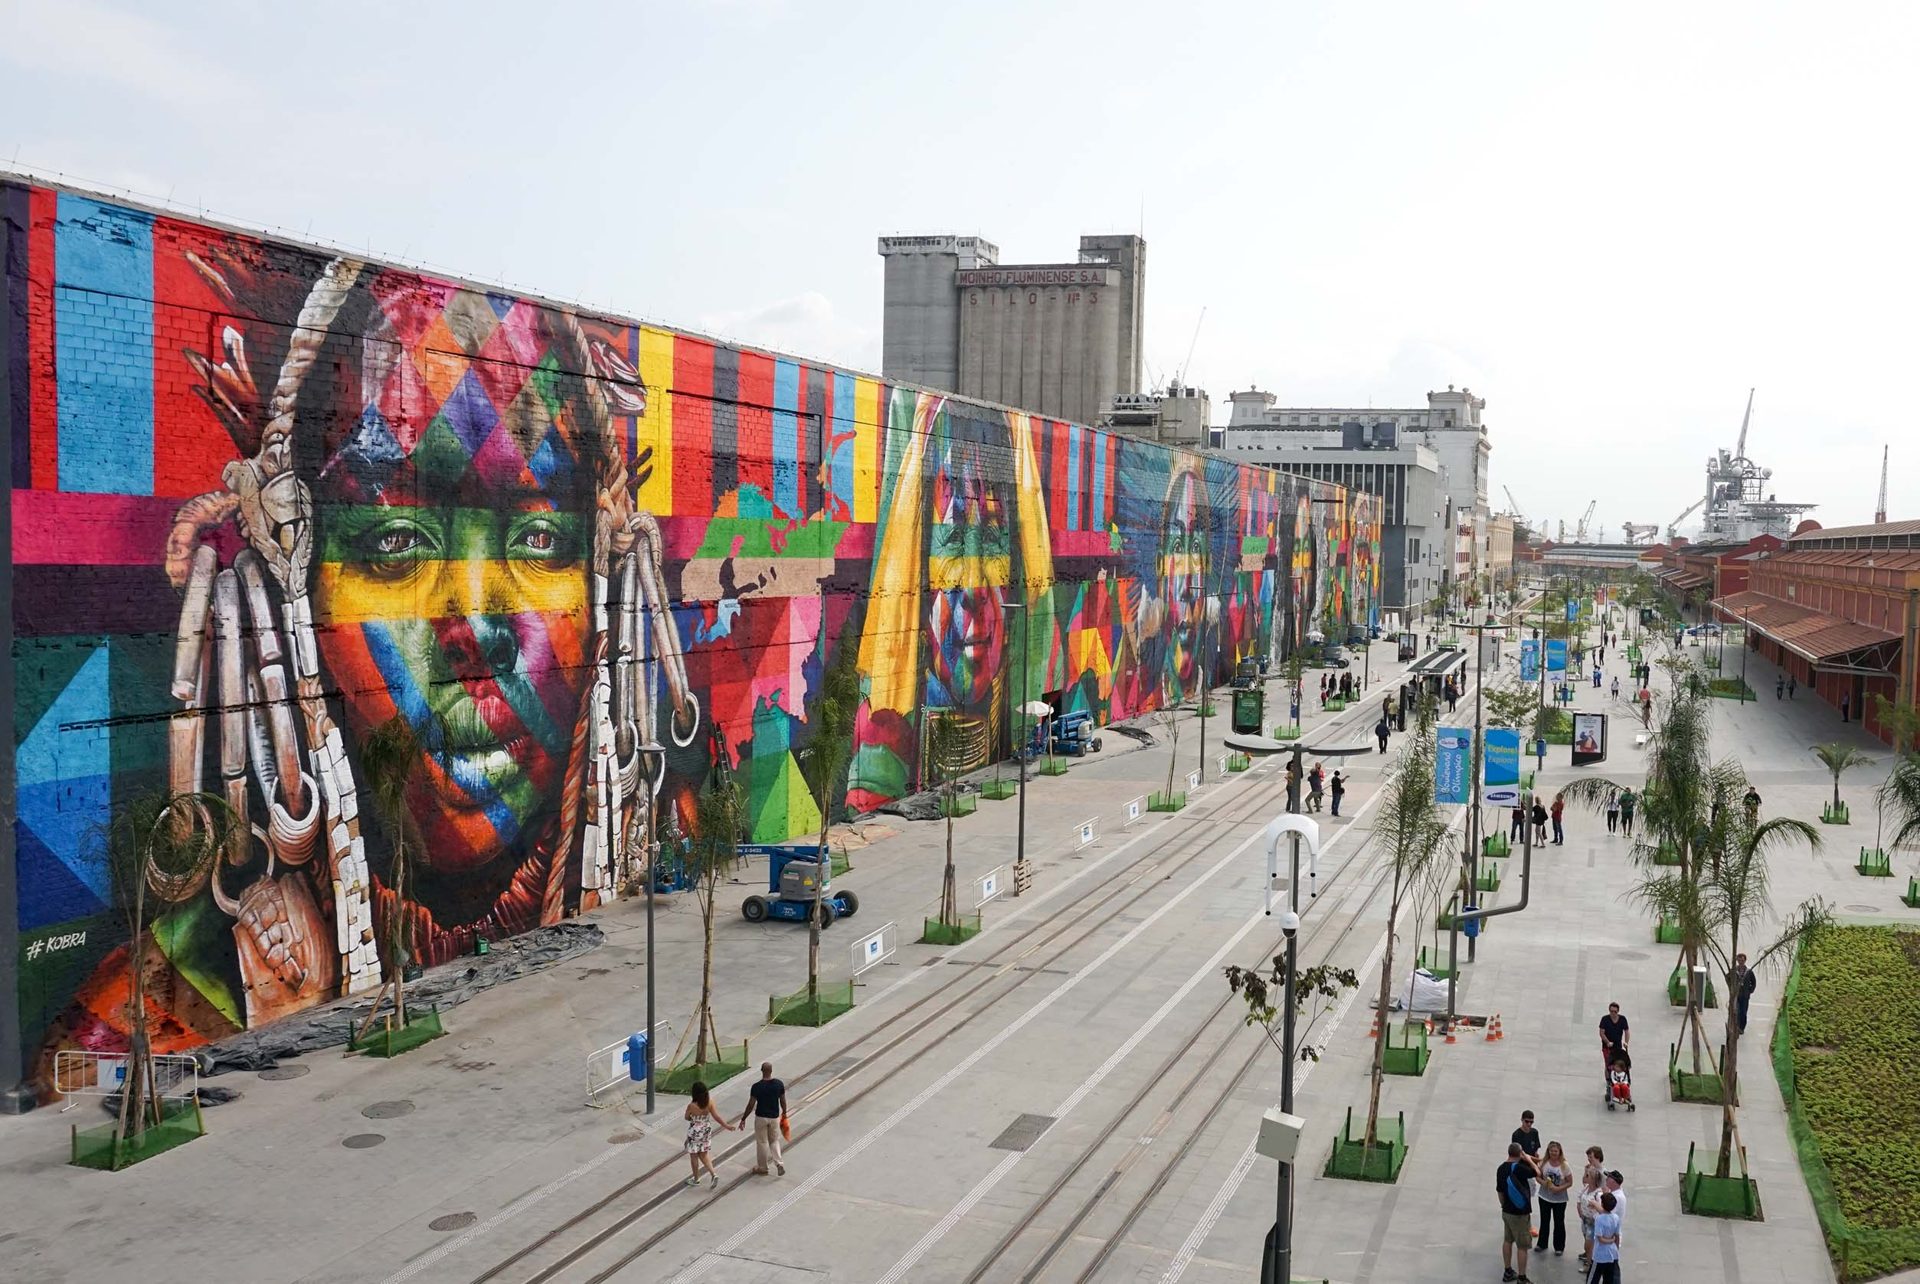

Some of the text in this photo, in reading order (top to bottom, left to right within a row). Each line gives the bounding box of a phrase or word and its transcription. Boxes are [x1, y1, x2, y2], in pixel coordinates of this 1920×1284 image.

[960, 270, 1100, 285] MOINHO FLUMINENSE S.A.
[1089, 292, 1098, 304] 3
[46, 931, 86, 953] KOBRA
